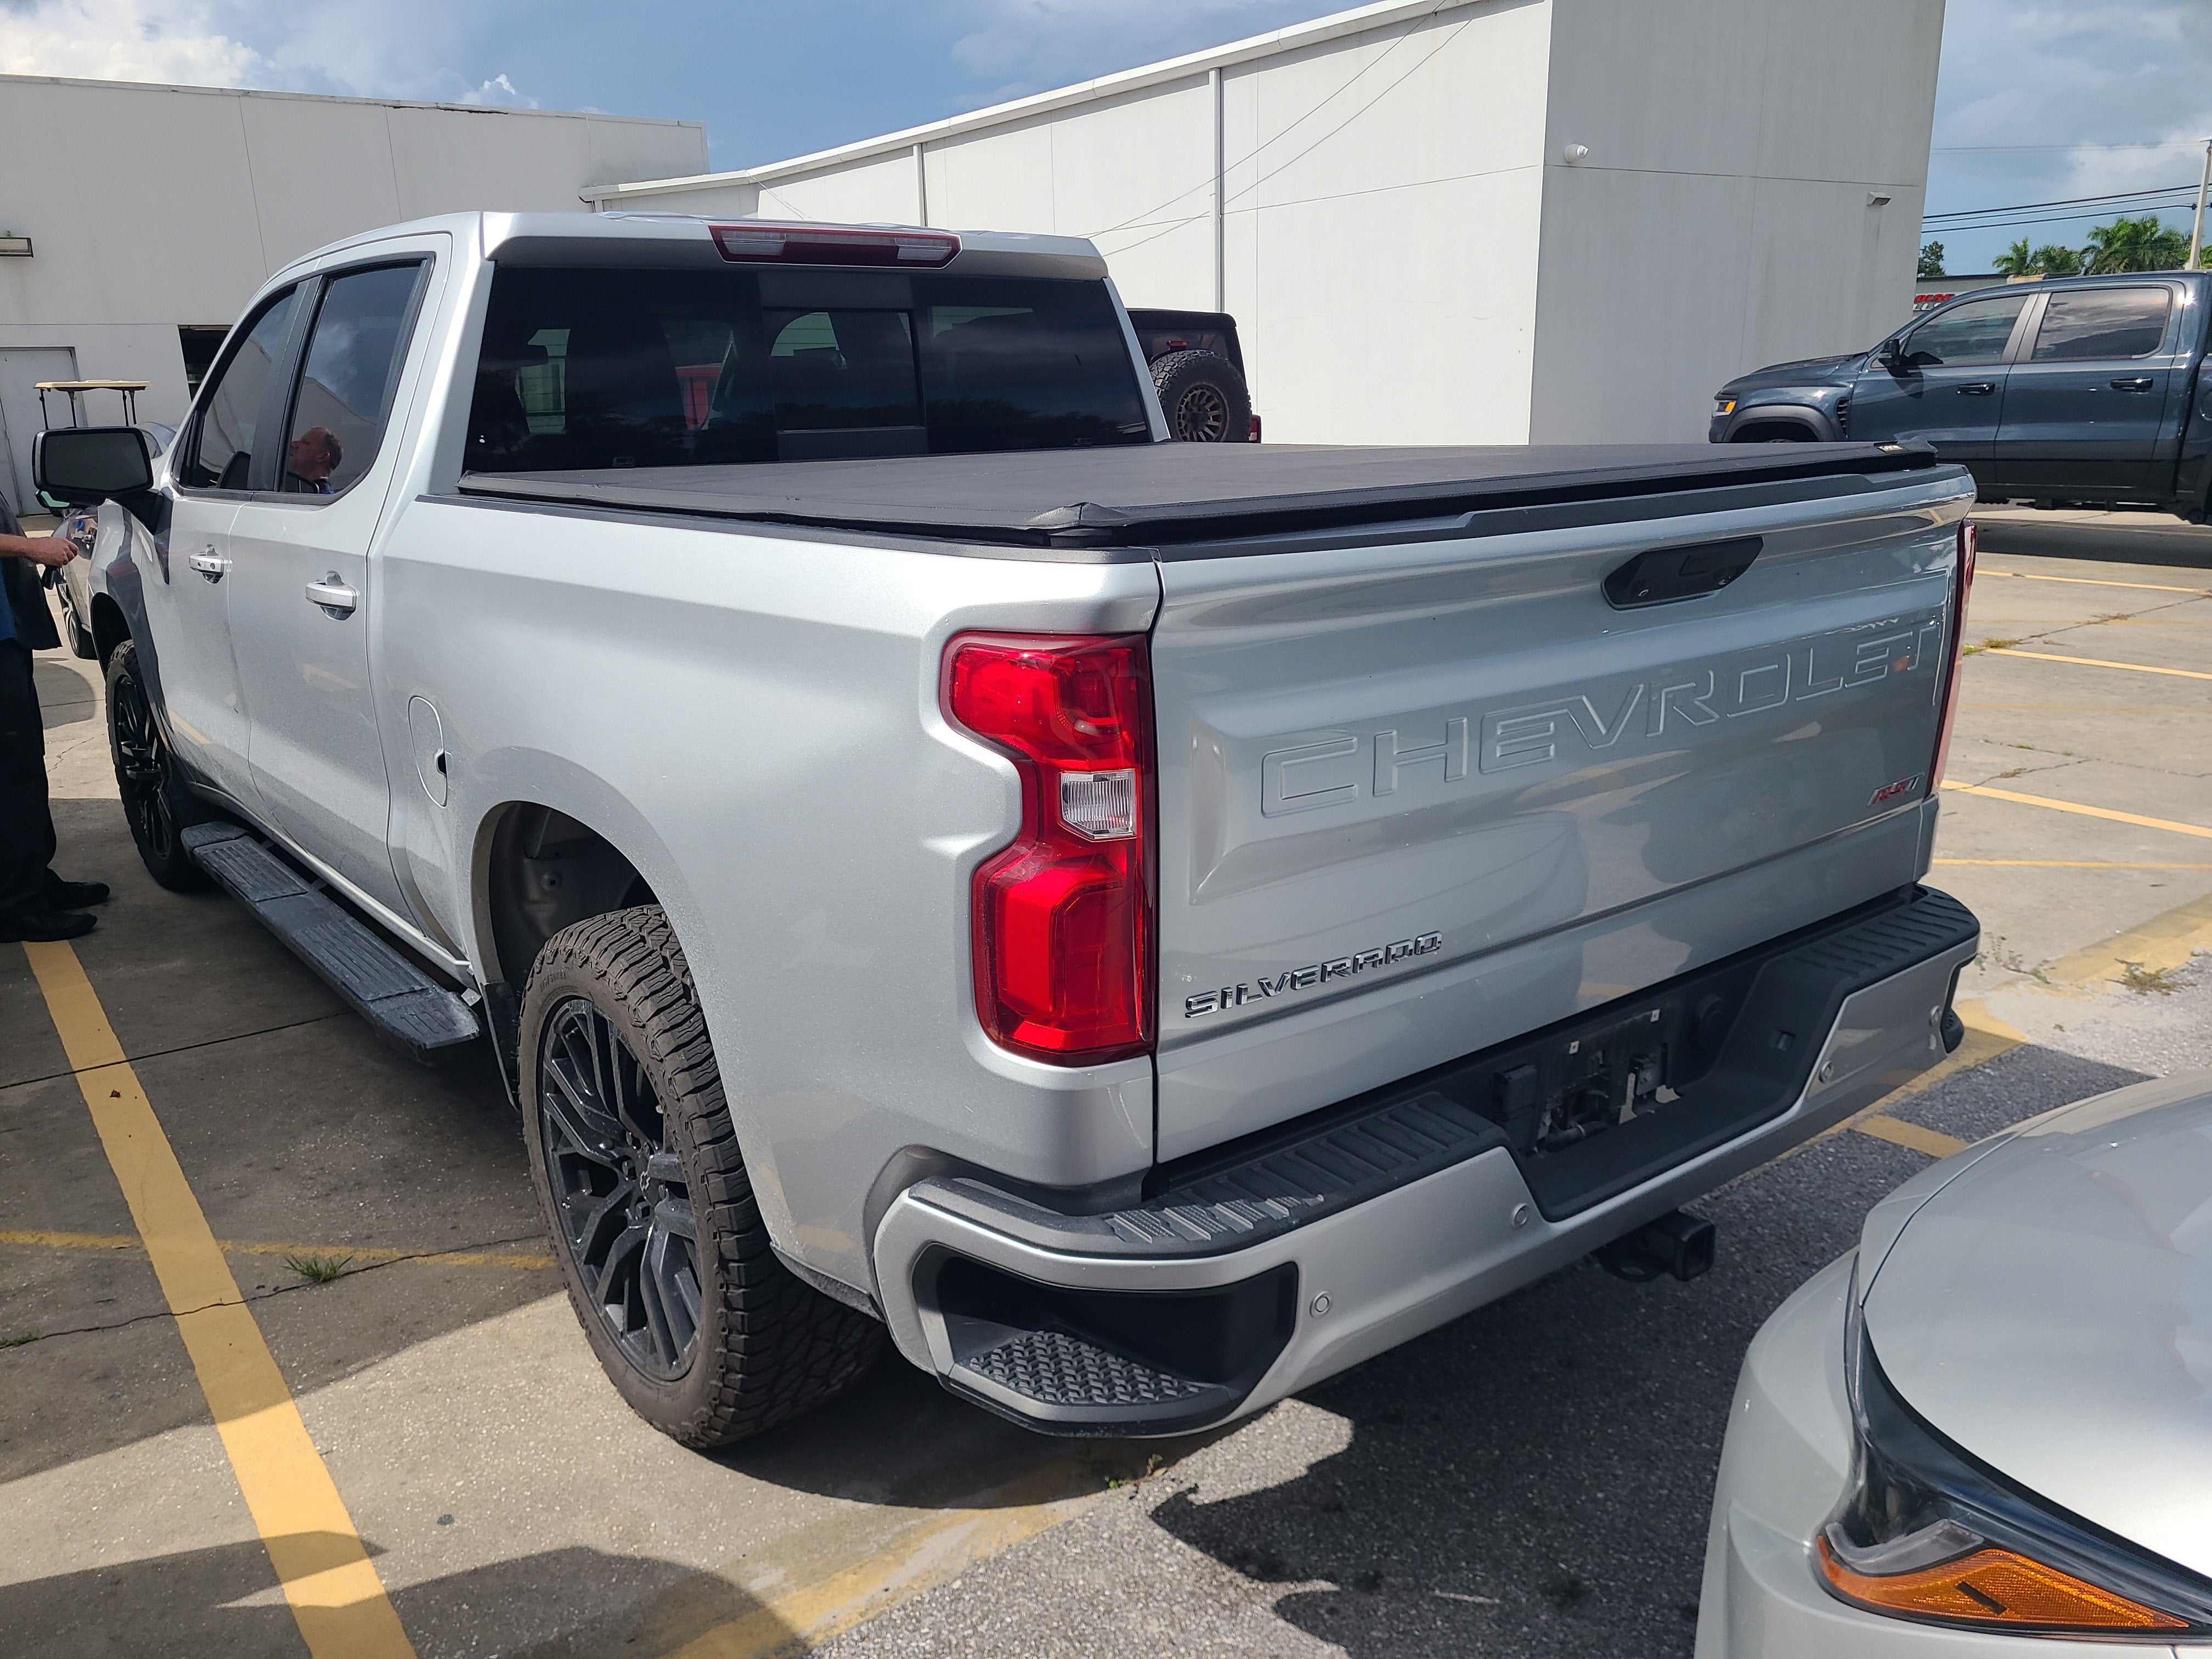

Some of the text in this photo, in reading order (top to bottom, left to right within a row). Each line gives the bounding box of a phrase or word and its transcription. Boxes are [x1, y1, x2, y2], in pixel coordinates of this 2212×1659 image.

[1261, 617, 1939, 819] CHEVROLET
[1867, 771, 1925, 806] RST
[1185, 930, 1443, 1018] SILVERADO
